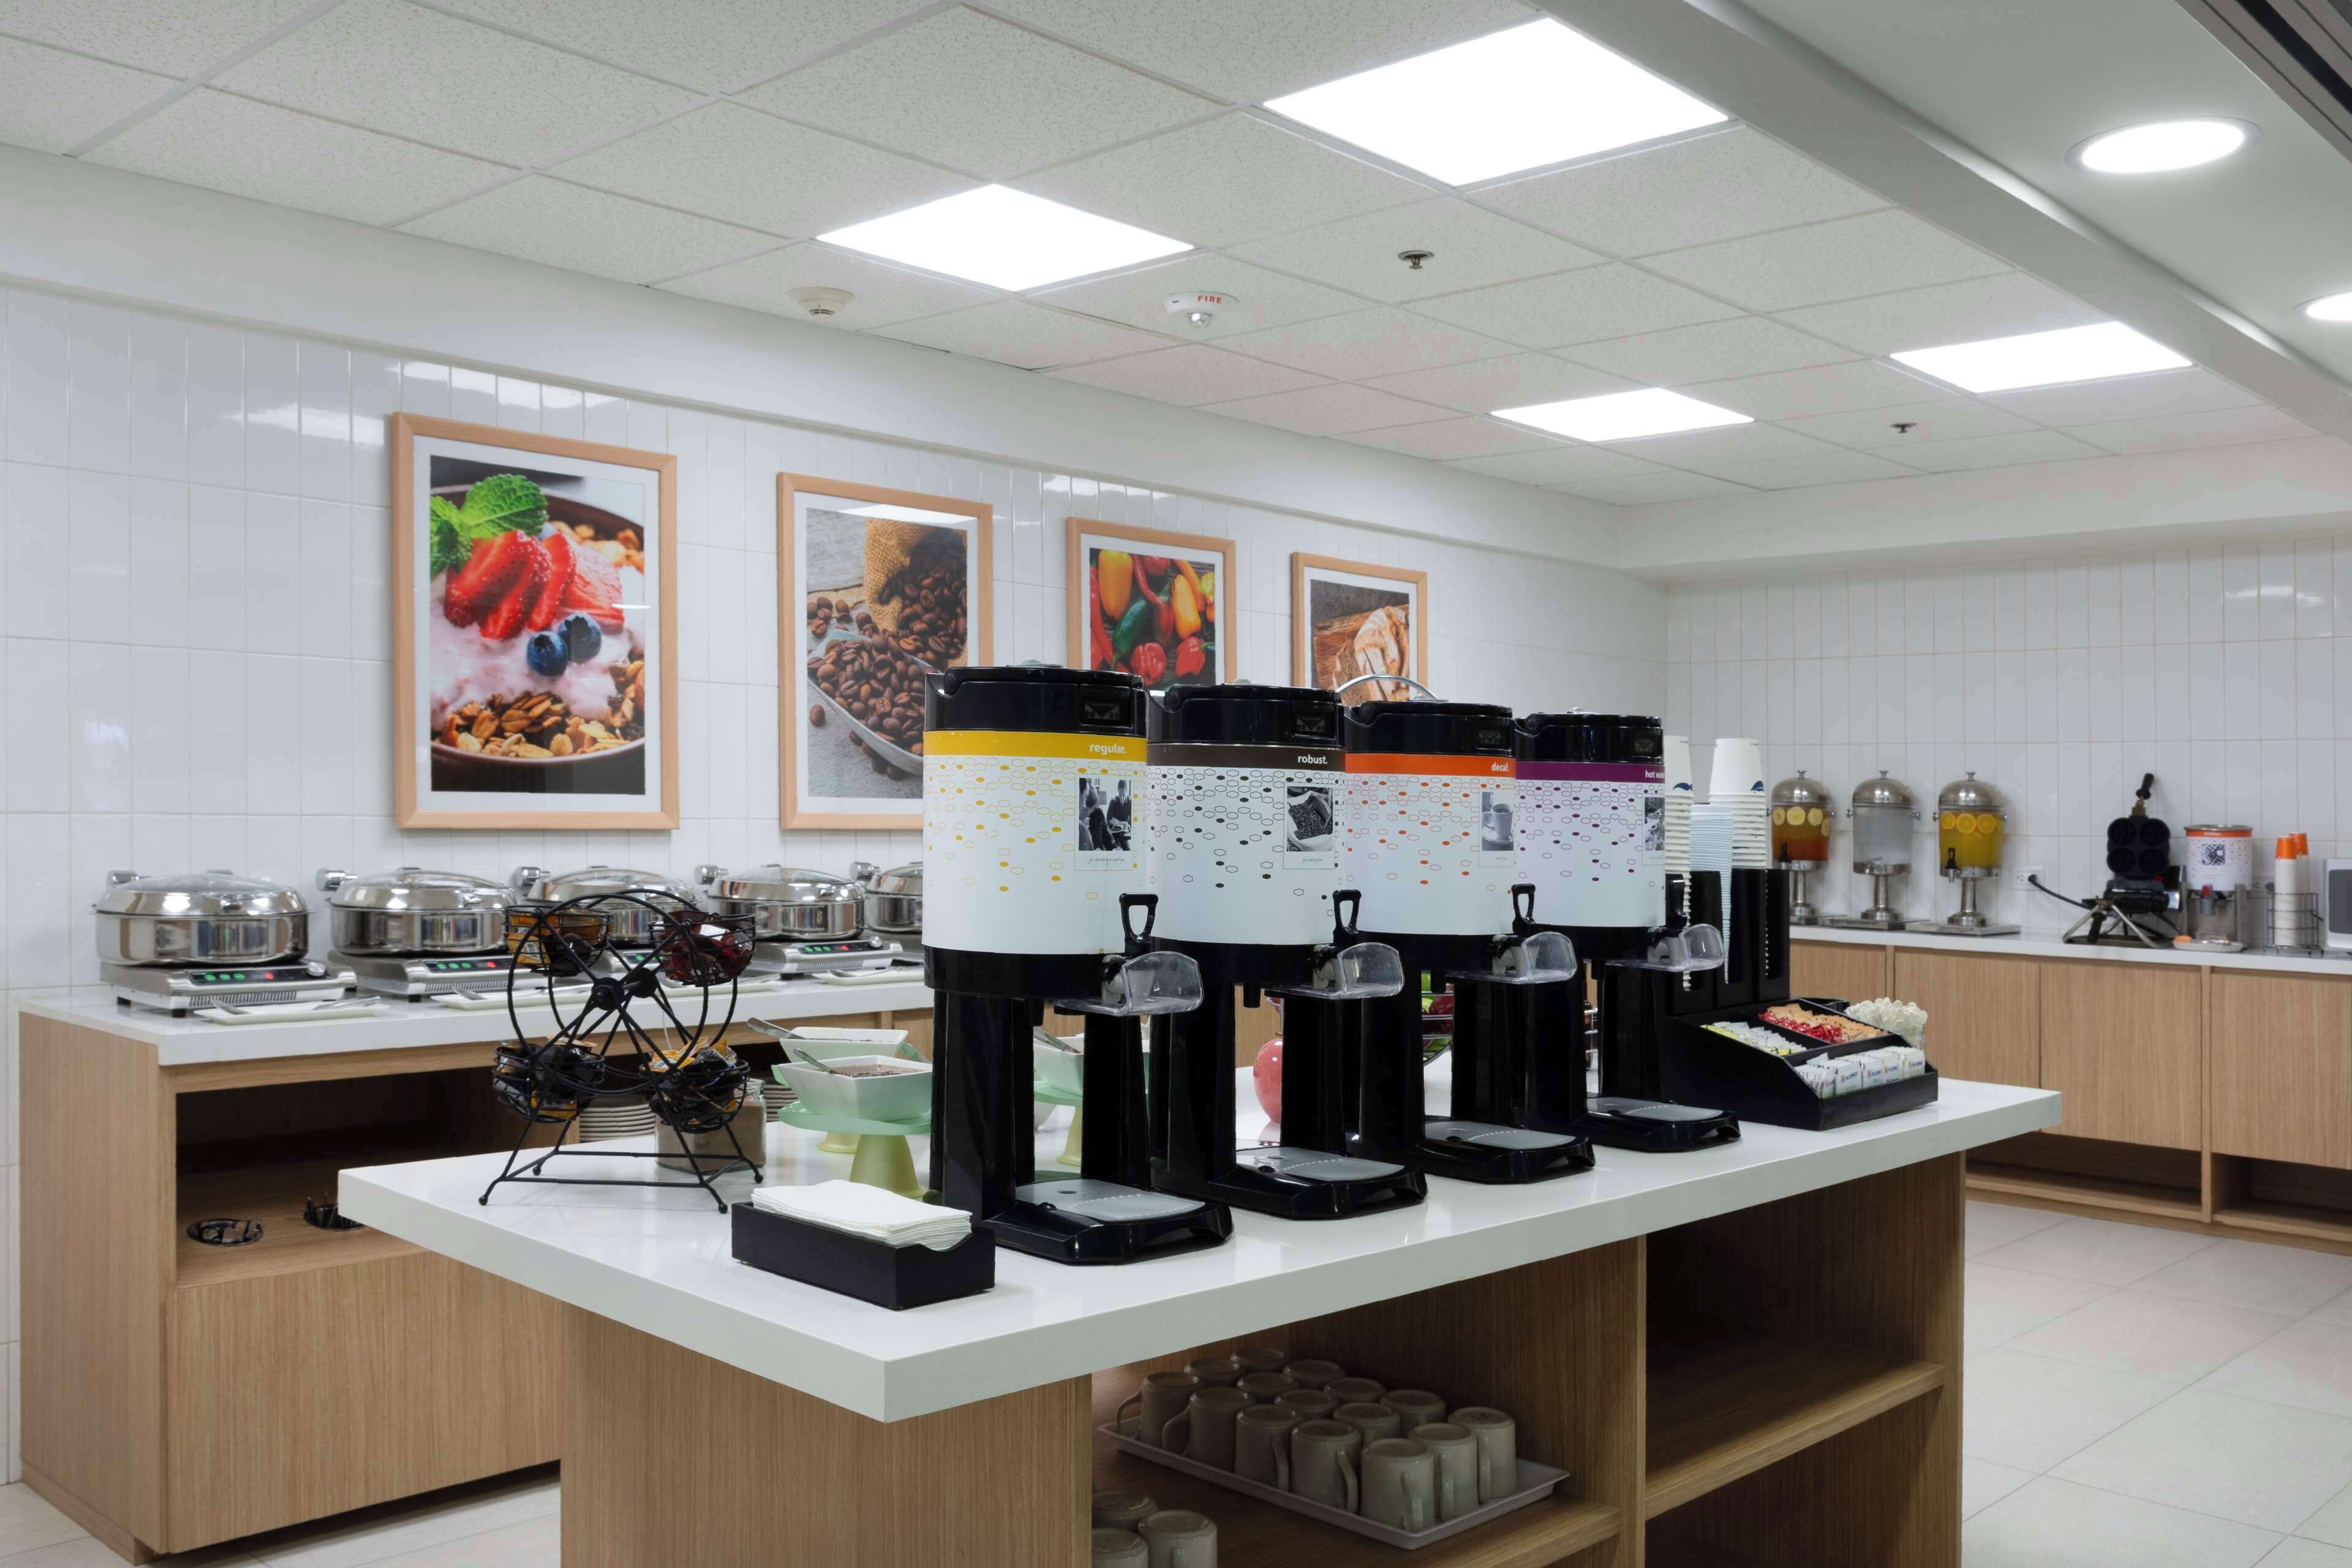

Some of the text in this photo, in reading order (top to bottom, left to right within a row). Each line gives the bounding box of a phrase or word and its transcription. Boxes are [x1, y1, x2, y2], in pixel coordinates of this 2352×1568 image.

[1197, 295, 1222, 304] FIRE
[1090, 743, 1126, 755] regular.
[1298, 755, 1328, 764] robust.
[1491, 762, 1509, 772] decaf.
